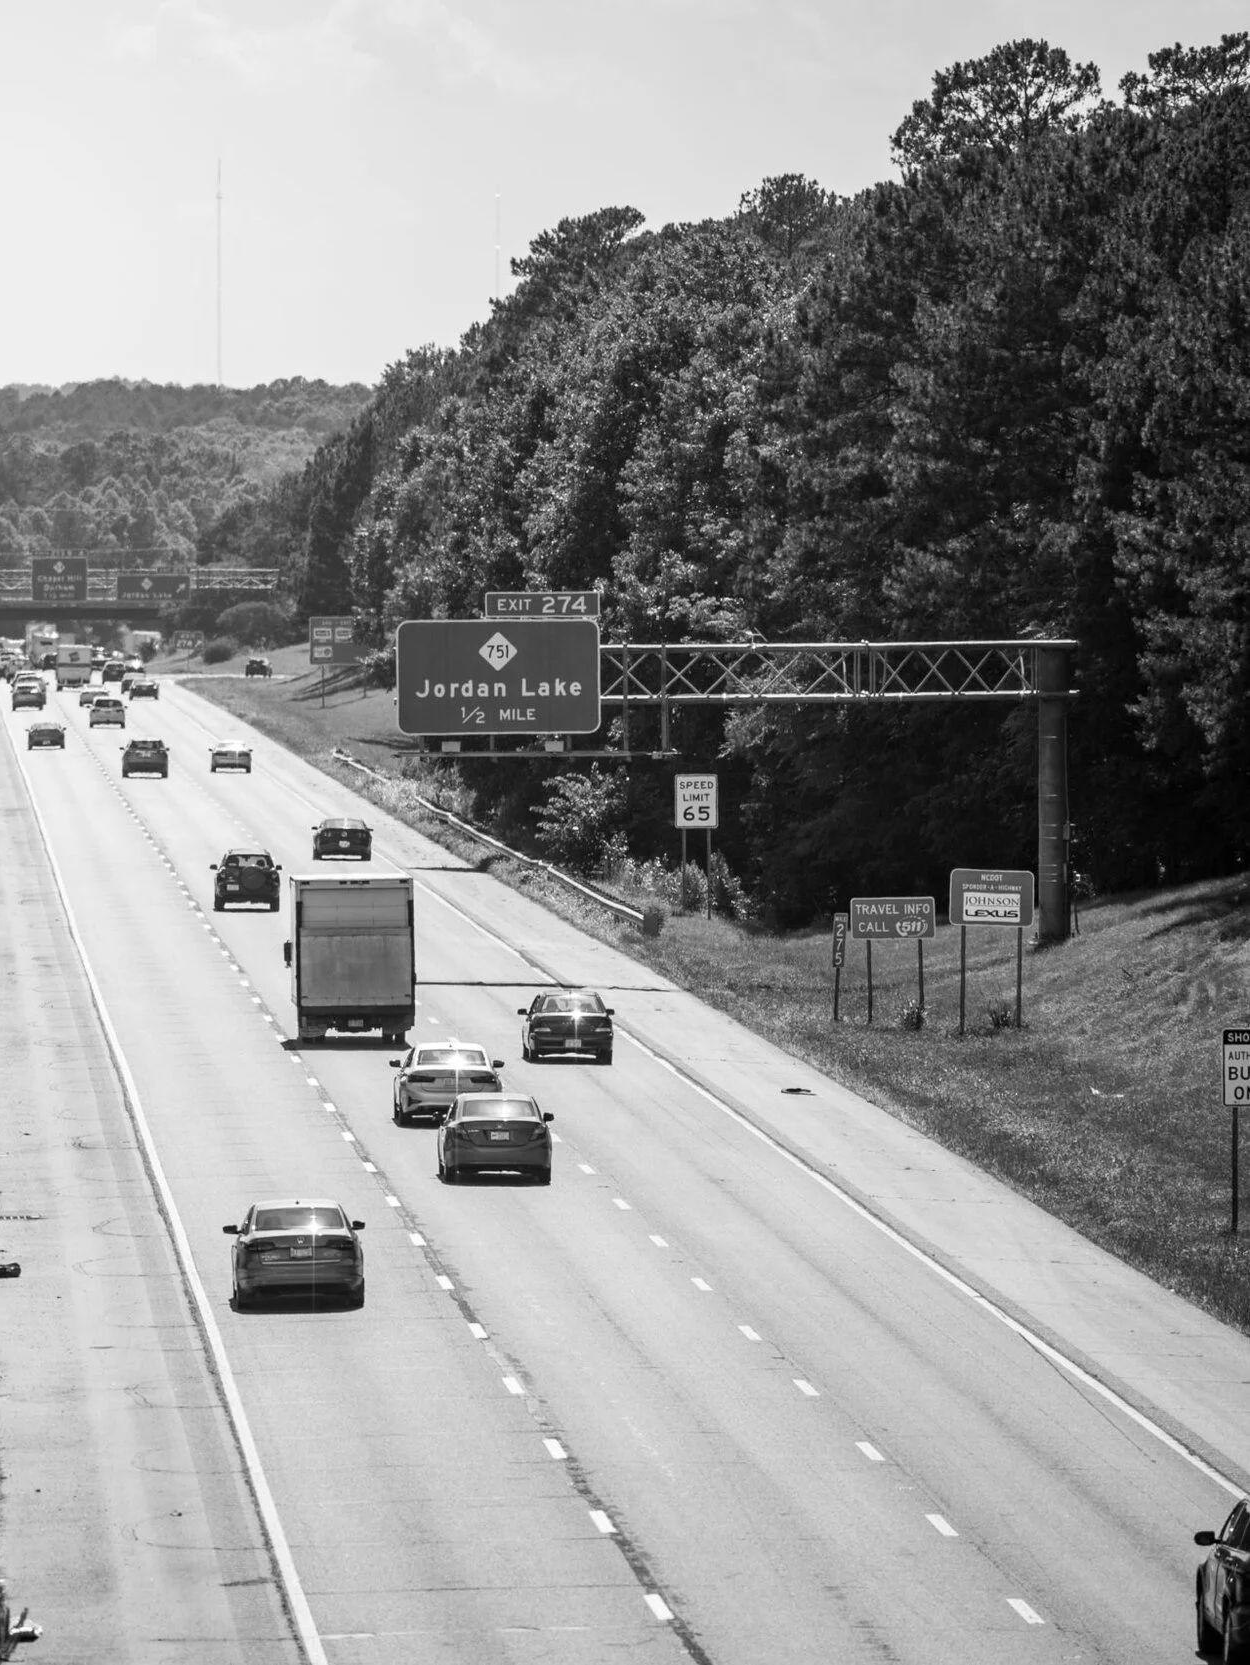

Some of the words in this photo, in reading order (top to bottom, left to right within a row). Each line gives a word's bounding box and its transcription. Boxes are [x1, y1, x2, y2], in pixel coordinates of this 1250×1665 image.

[497, 598, 532, 611] EXIT
[542, 595, 587, 613] 274
[487, 644, 509, 659] 751
[415, 679, 507, 698] Jordan
[521, 678, 582, 697] Lake
[499, 708, 536, 721] MILE
[679, 781, 714, 790] SPEED
[682, 793, 711, 802] LIMIT
[683, 805, 711, 821] 65
[965, 896, 1020, 906] JOHNSON
[855, 903, 900, 915] TRAVEL
[904, 903, 930, 914] INFO
[965, 909, 1019, 918] LEXUS
[858, 922, 890, 933] CALL
[901, 921, 922, 932] 511
[1227, 1032, 1250, 1042] SHO
